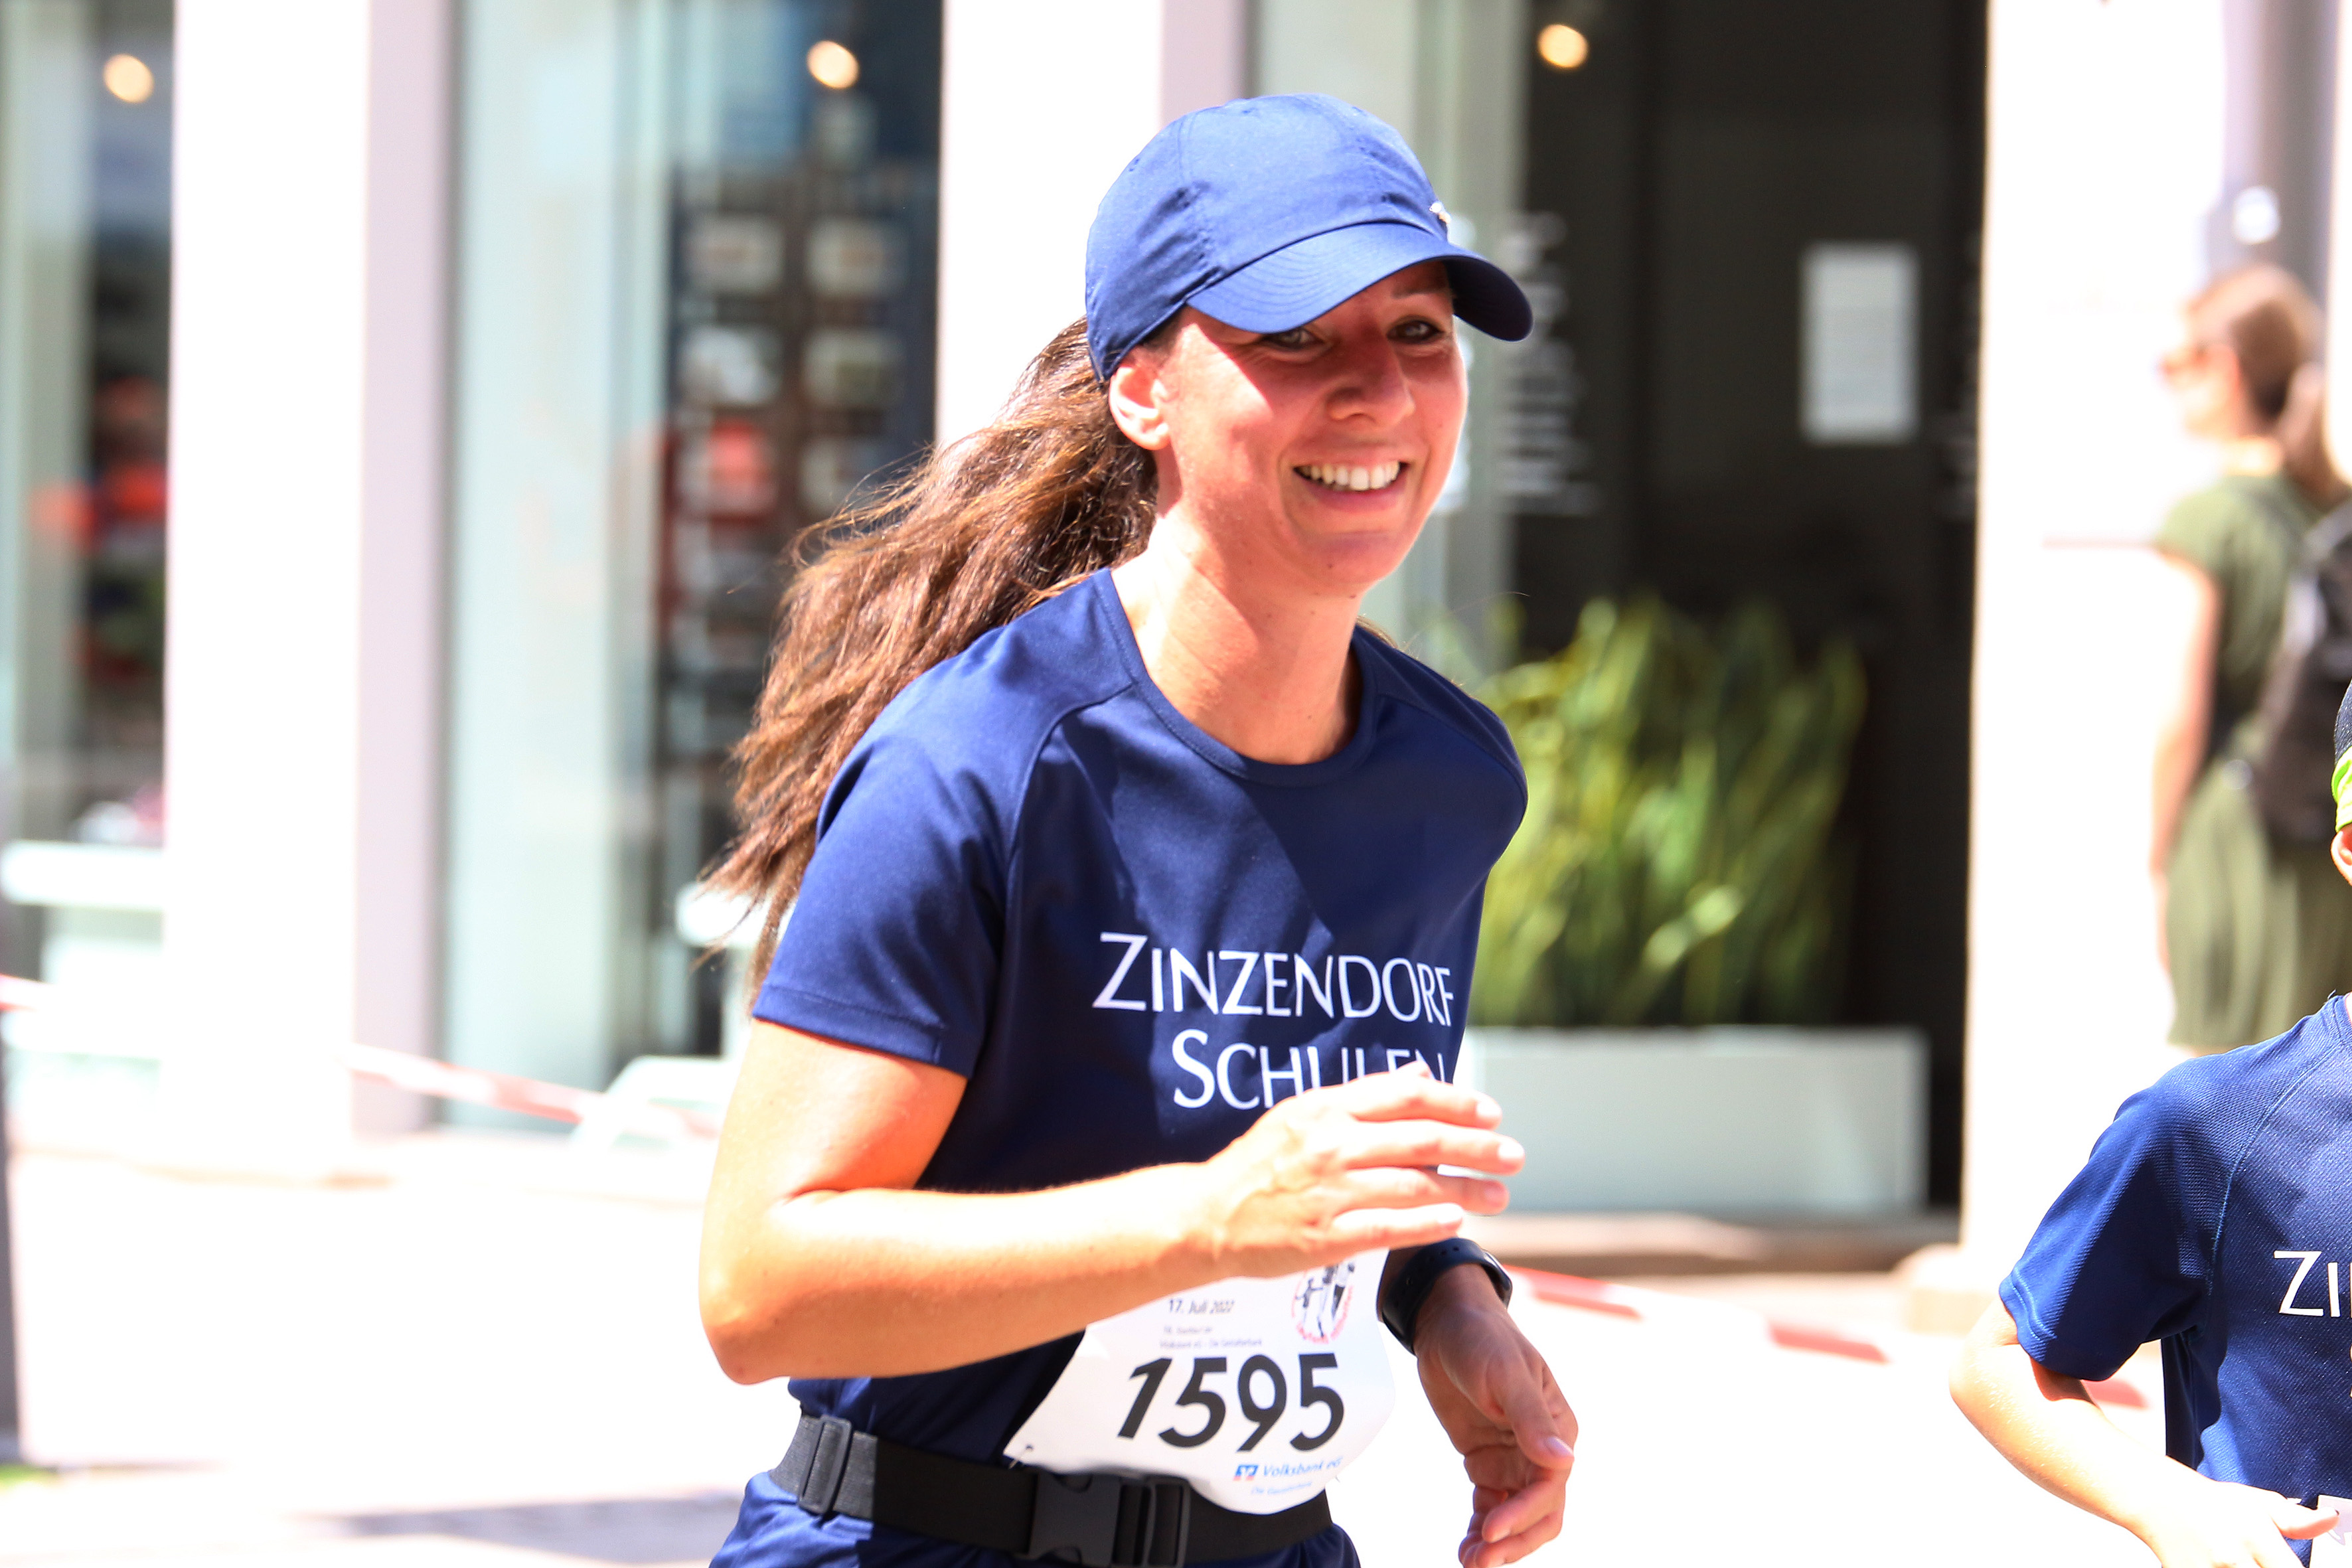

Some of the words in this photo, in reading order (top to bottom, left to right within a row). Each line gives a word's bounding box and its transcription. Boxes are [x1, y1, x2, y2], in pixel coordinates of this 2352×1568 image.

[1092, 932, 1454, 1026] ZINZENDORF
[2274, 1250, 2352, 1318] ZI
[1117, 1354, 1344, 1452] 1595
